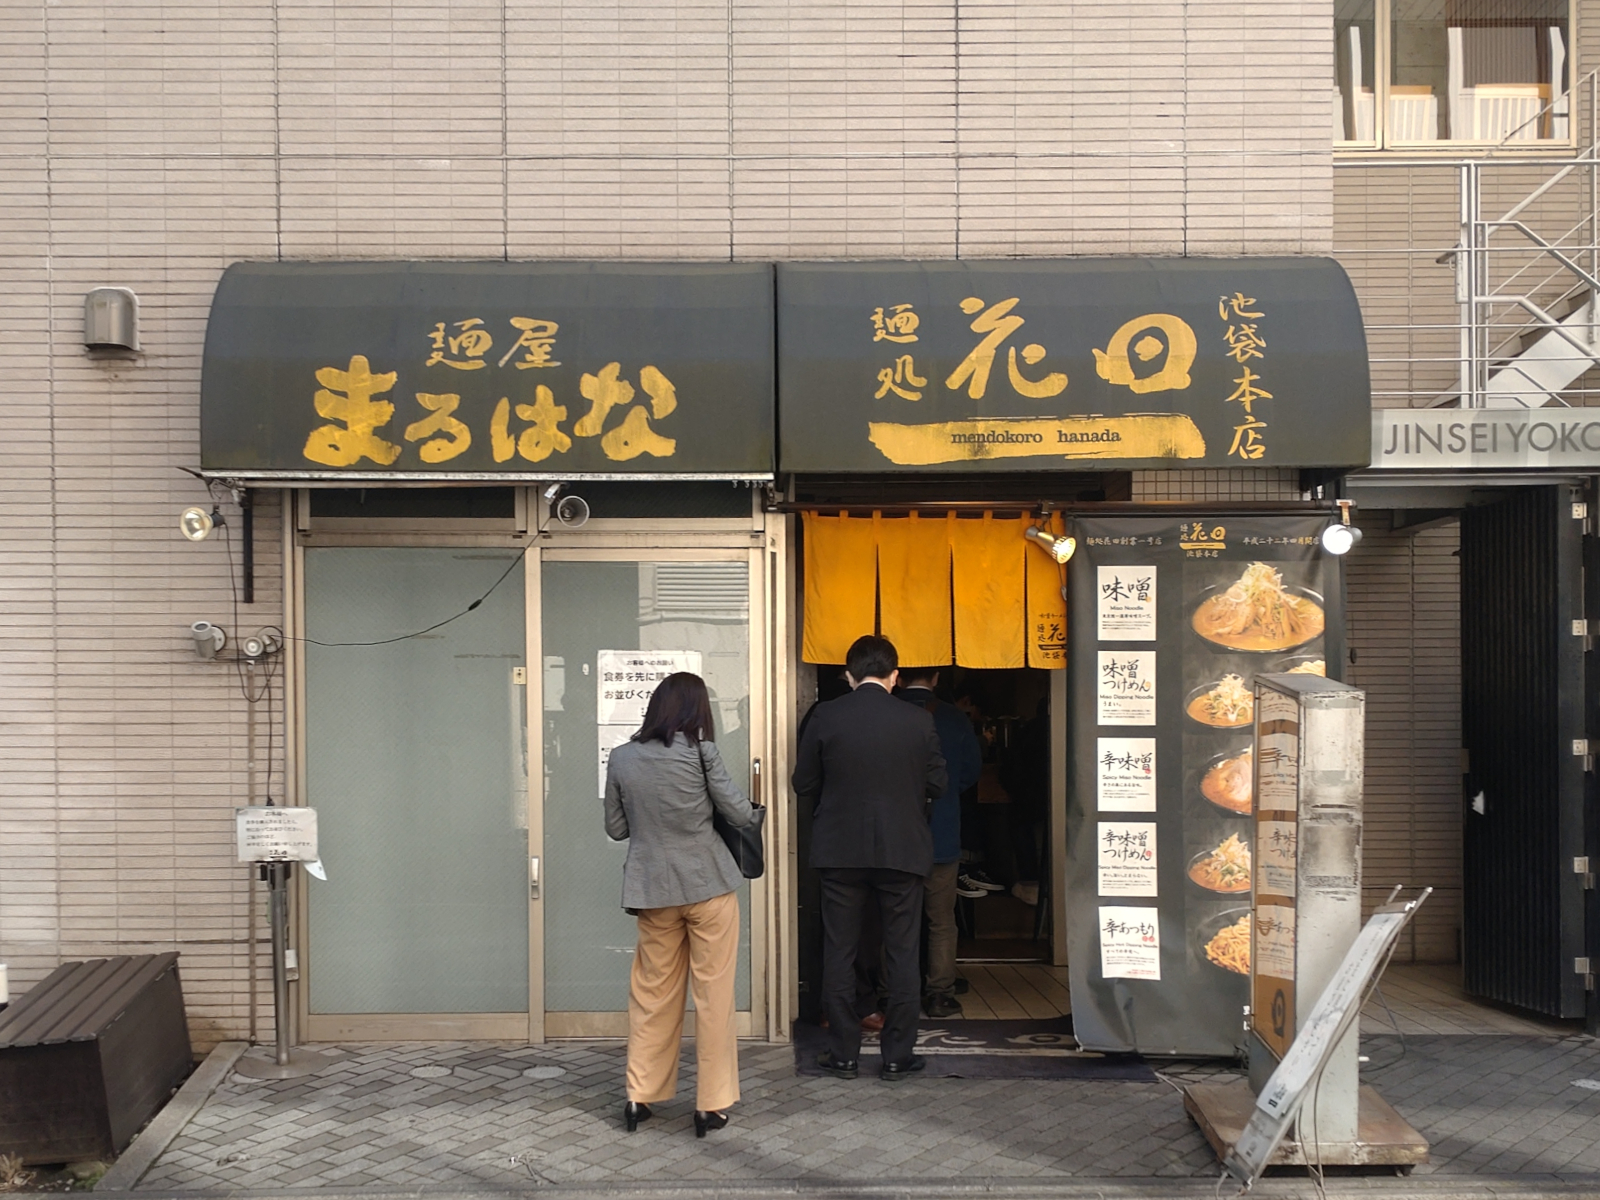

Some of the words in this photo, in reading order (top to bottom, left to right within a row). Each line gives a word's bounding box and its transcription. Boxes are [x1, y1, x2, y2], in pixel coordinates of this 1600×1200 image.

[1218, 292, 1273, 460] 池袋本店
[303, 355, 678, 467] まるはな
[951, 430, 1043, 444] mendokoro
[1057, 429, 1122, 443] hanada
[1102, 575, 1152, 602] 味噌
[1102, 658, 1140, 679] 味噌
[1103, 677, 1151, 694] つけめん
[1100, 750, 1152, 771] 辛味噌
[1102, 829, 1148, 847] 辛味噌
[1103, 847, 1152, 862] つけめん
[1102, 918, 1155, 939] 辛あつもり
